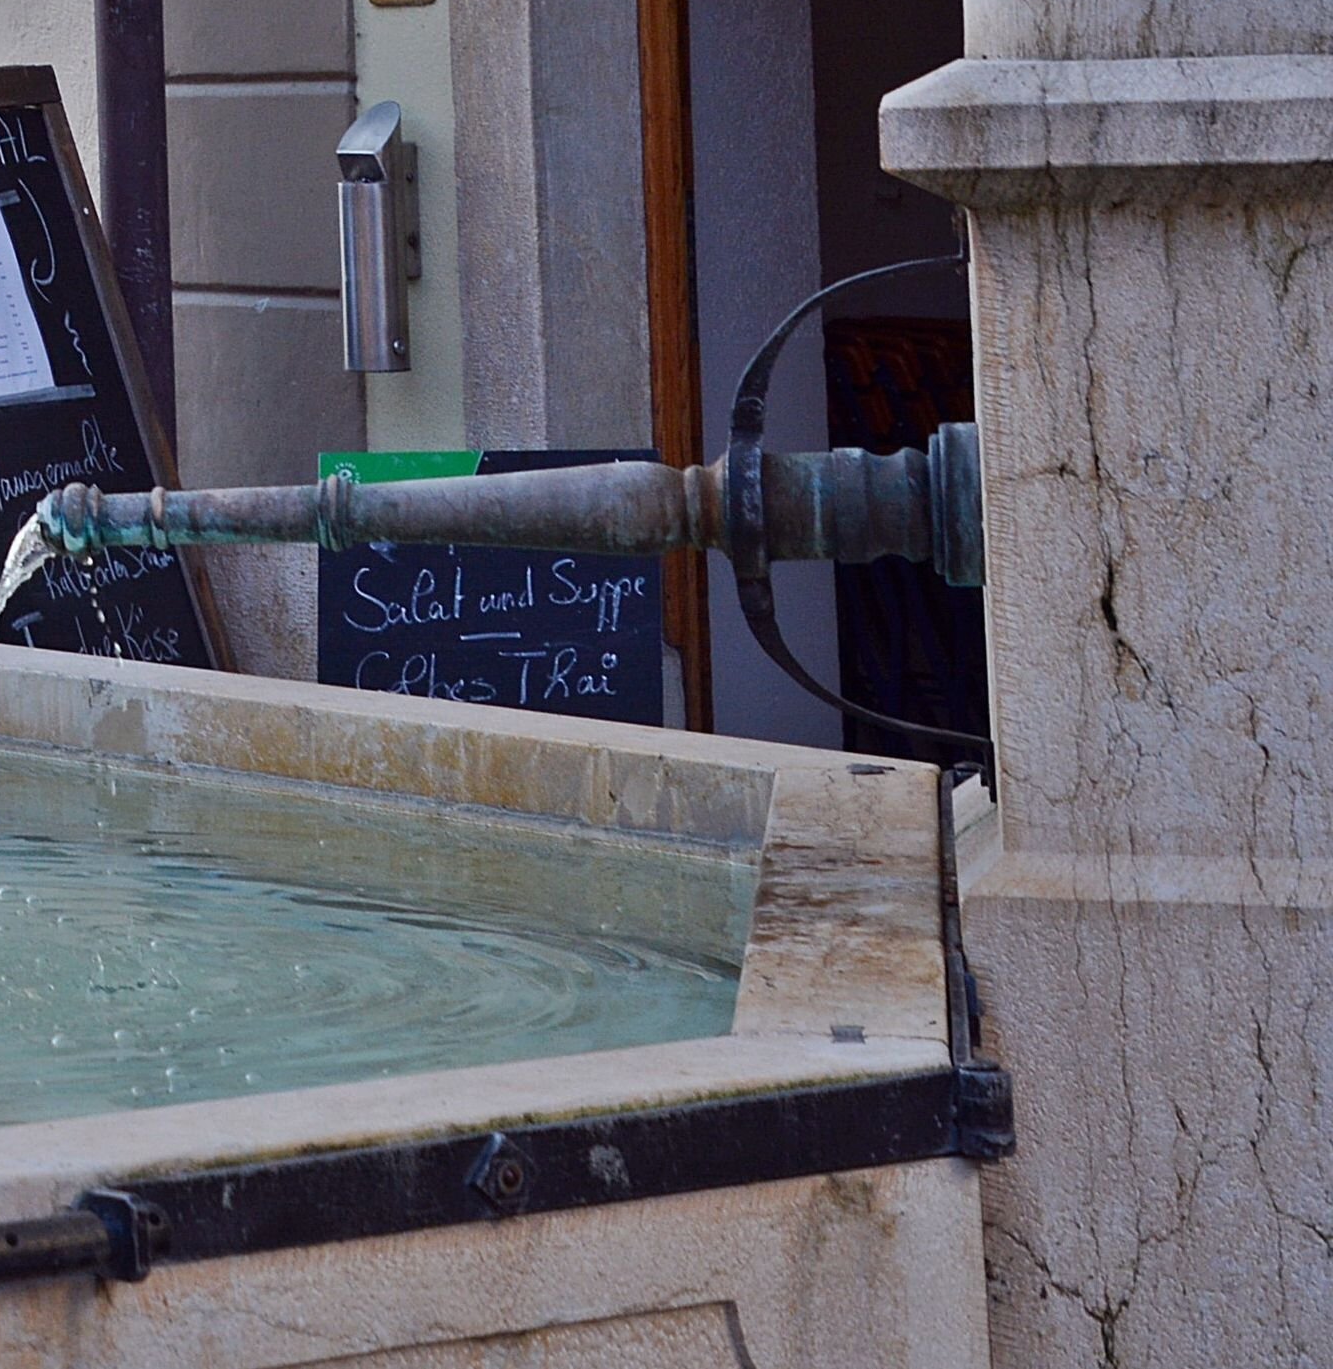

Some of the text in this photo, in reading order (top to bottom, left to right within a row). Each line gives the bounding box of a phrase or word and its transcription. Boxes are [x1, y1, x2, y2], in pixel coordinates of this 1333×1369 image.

[343, 558, 647, 633] Salat und Suppe
